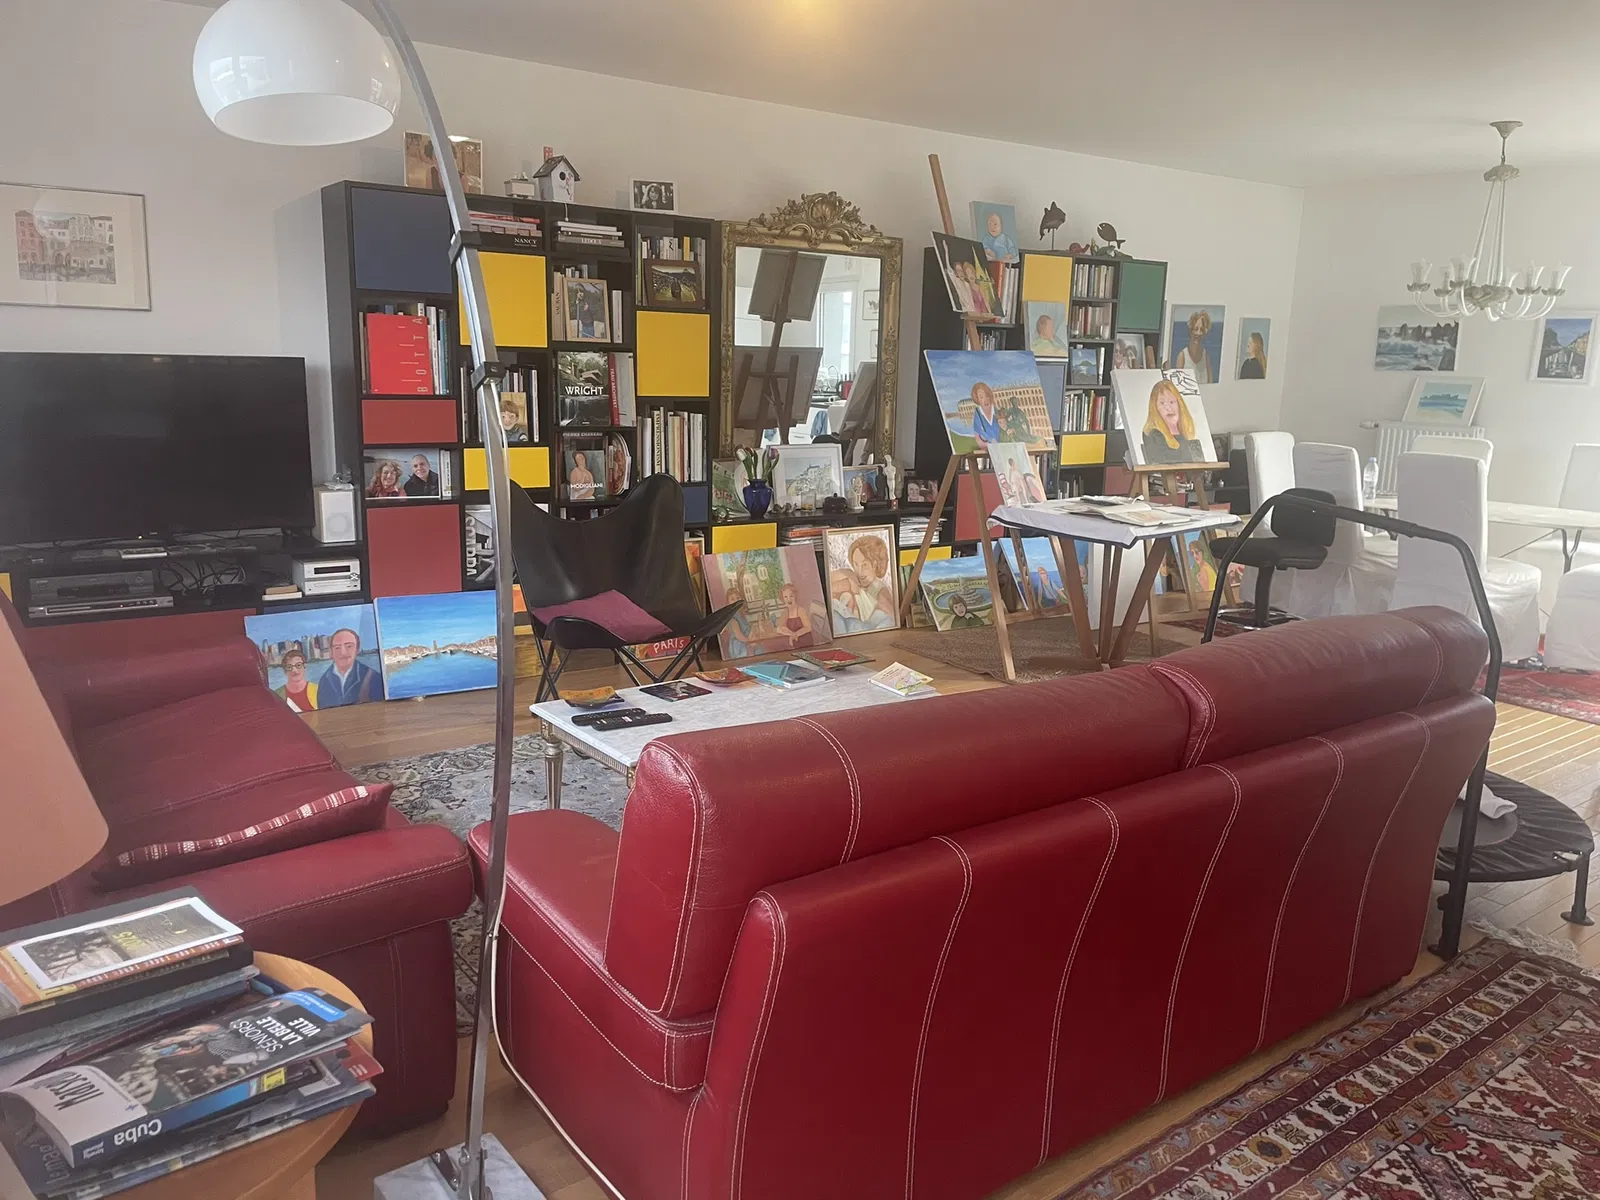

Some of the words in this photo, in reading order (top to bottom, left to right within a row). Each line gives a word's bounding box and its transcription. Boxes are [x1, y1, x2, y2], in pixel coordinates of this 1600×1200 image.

[565, 386, 604, 395] WRIGHT
[653, 638, 685, 653] PARIS
[256, 1016, 292, 1037] BELLE
[287, 1017, 321, 1037] VILLE
[281, 1031, 304, 1046] LA
[113, 1118, 162, 1146] Cuba
